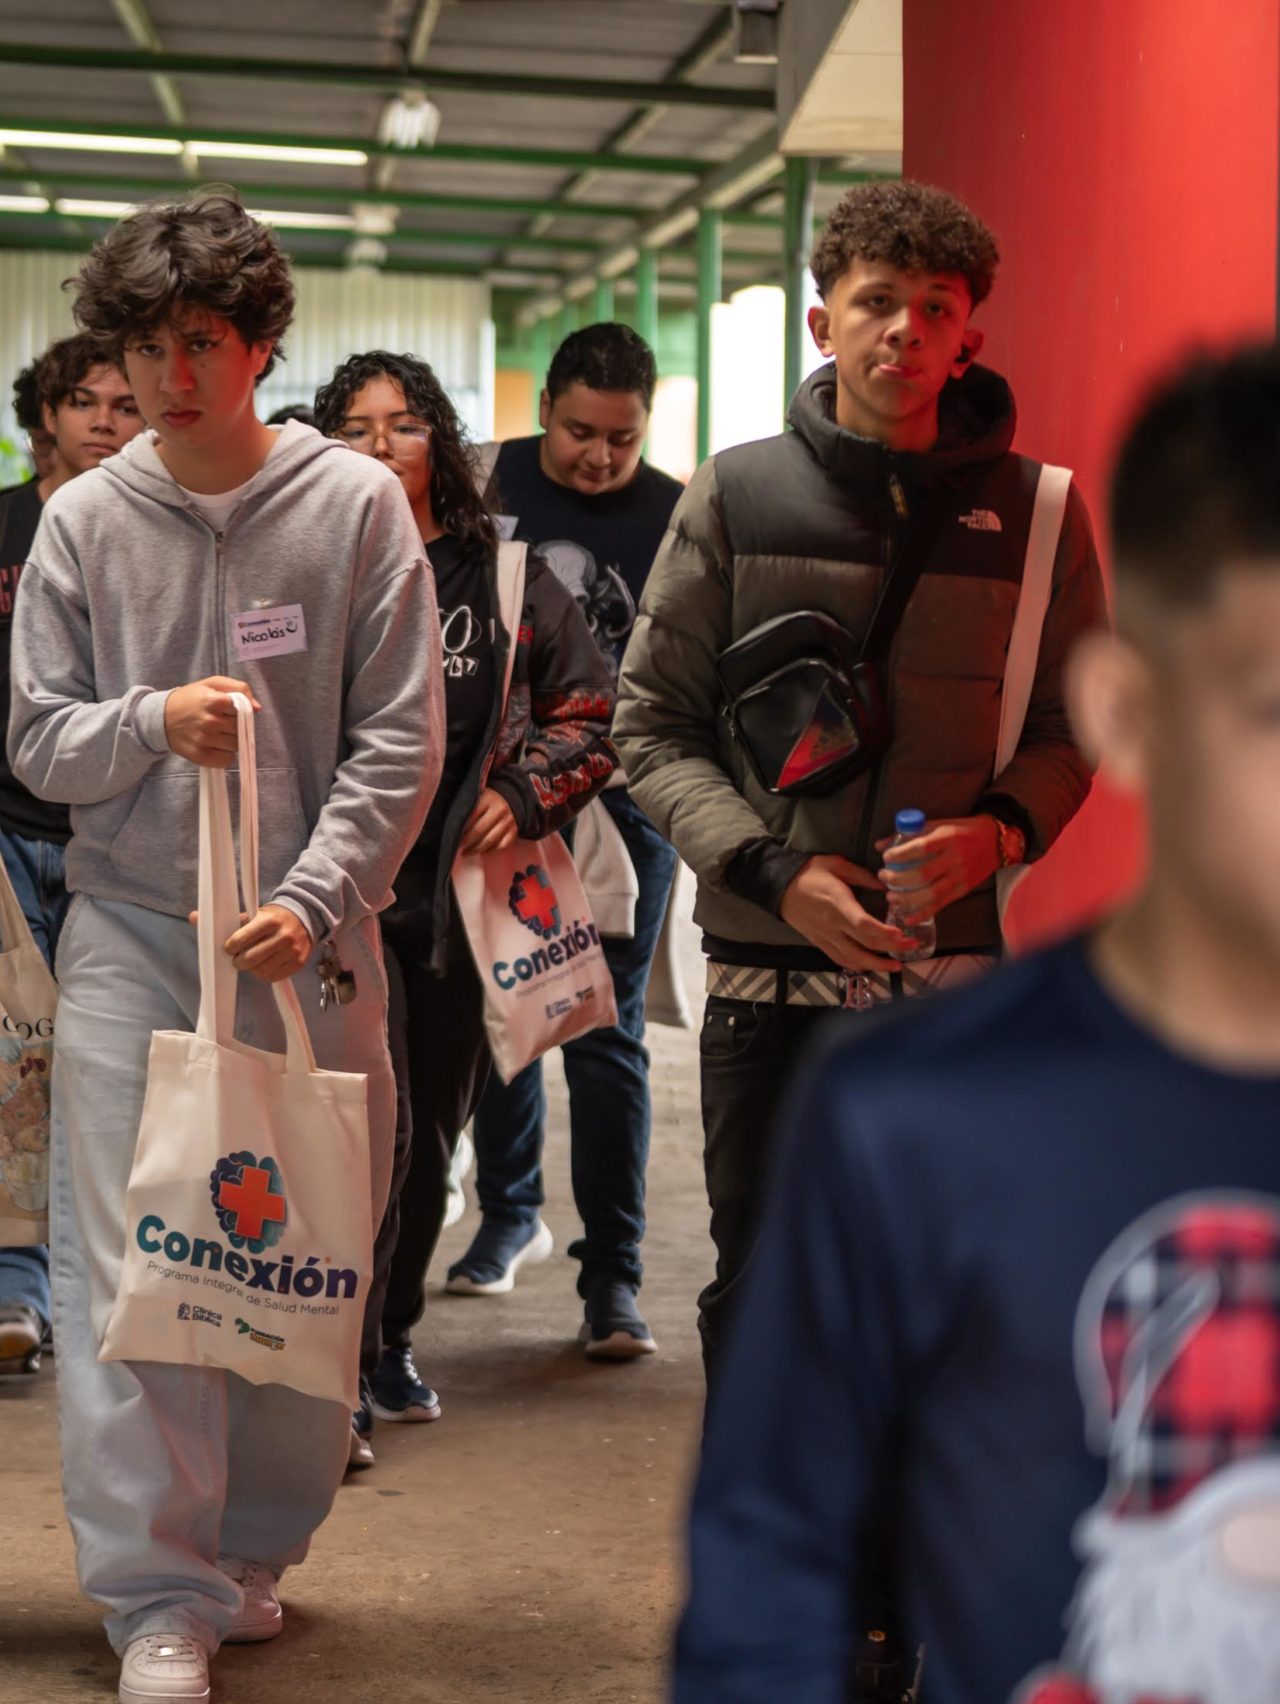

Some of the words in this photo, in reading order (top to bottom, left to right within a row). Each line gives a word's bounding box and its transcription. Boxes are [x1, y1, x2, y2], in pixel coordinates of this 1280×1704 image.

[136, 1214, 358, 1299] Conexión
[147, 1260, 200, 1284] Programa
[203, 1276, 245, 1298] Integral
[246, 1294, 261, 1306] de
[264, 1297, 297, 1313] Salud
[300, 1303, 339, 1316] Mental
